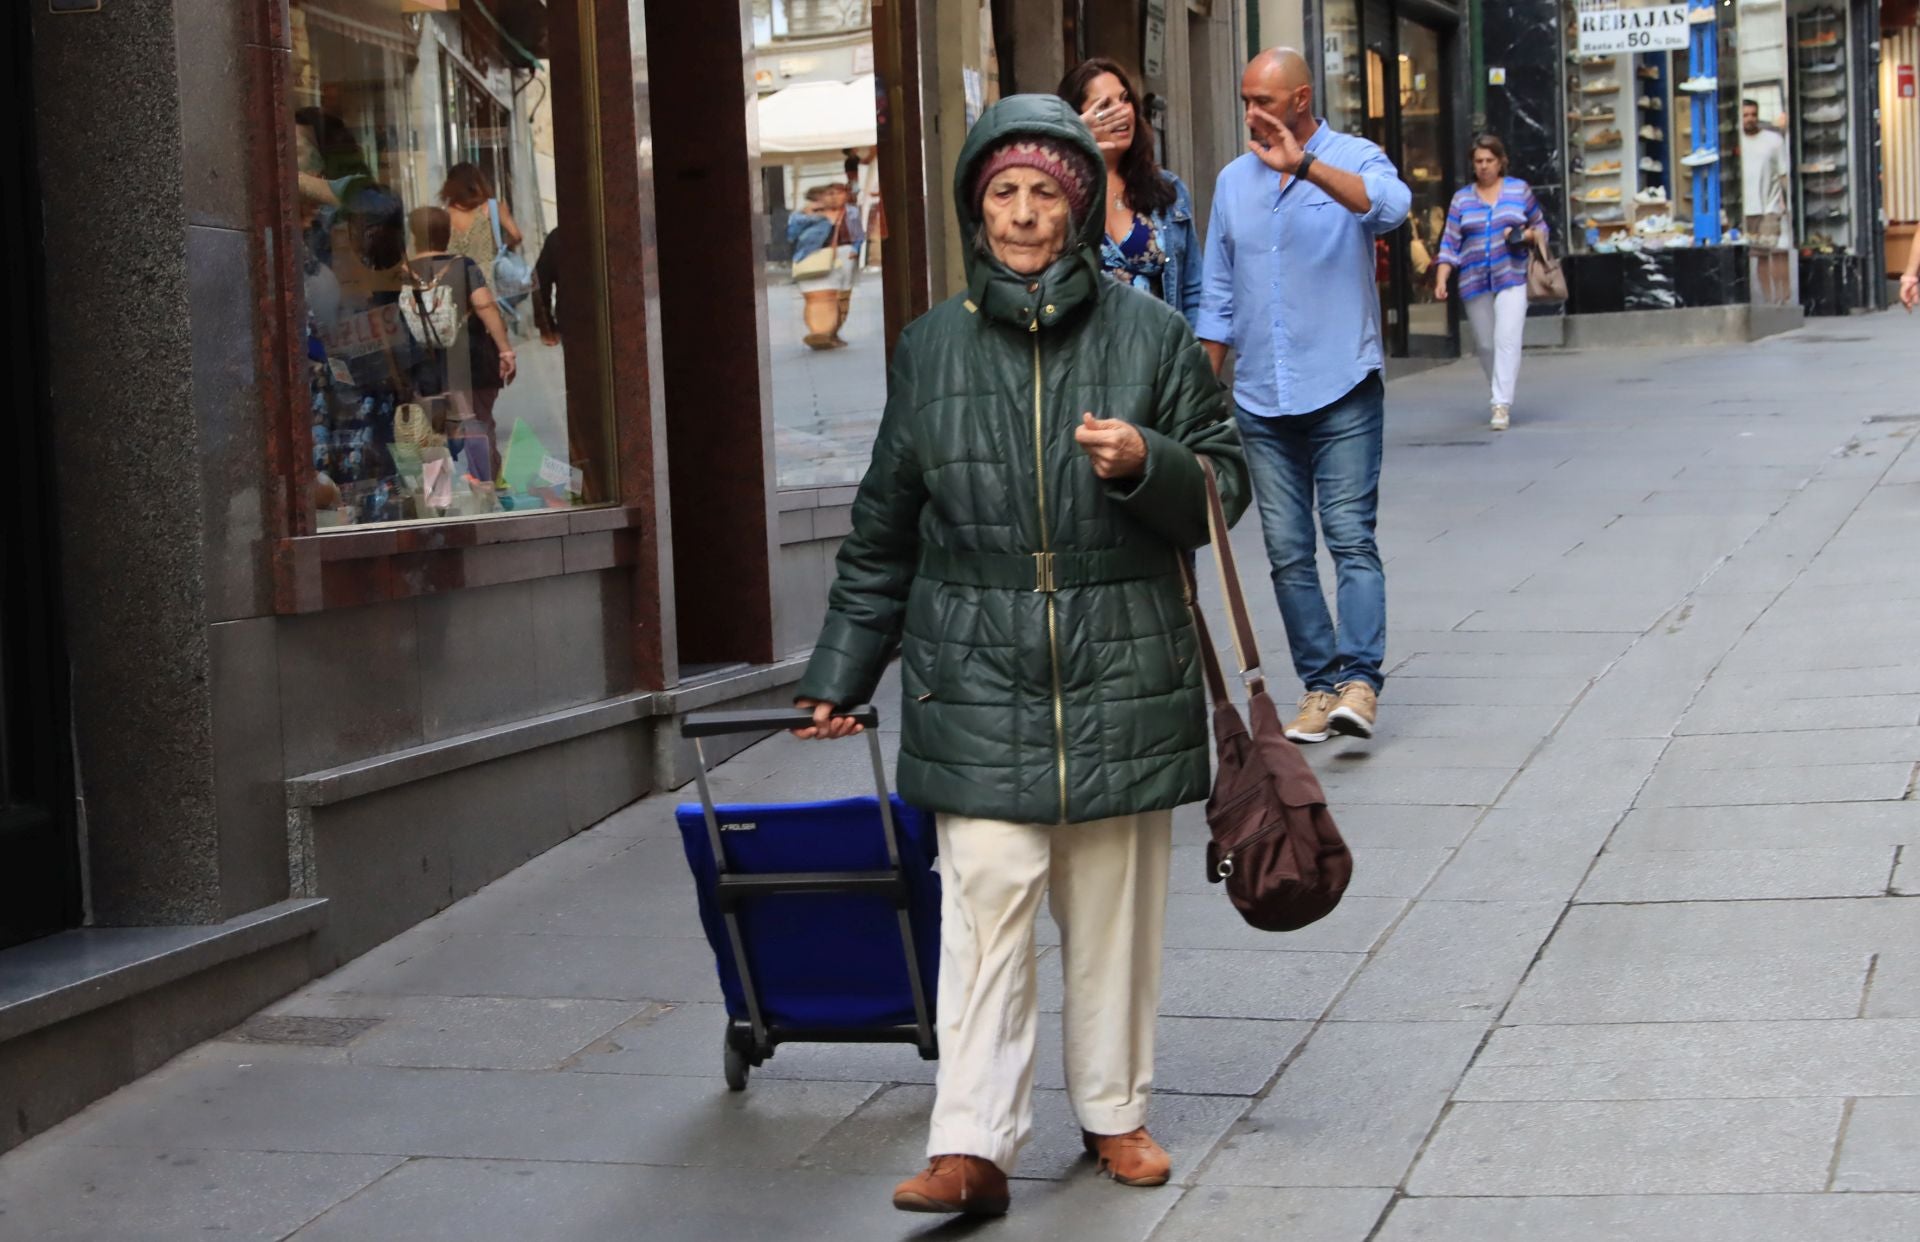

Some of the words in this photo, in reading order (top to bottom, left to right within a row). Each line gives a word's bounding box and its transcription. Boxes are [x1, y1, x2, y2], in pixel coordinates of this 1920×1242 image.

[1582, 9, 1684, 31] REBAJAS
[1584, 43, 1612, 51] Hasta
[1627, 31, 1650, 47] 50
